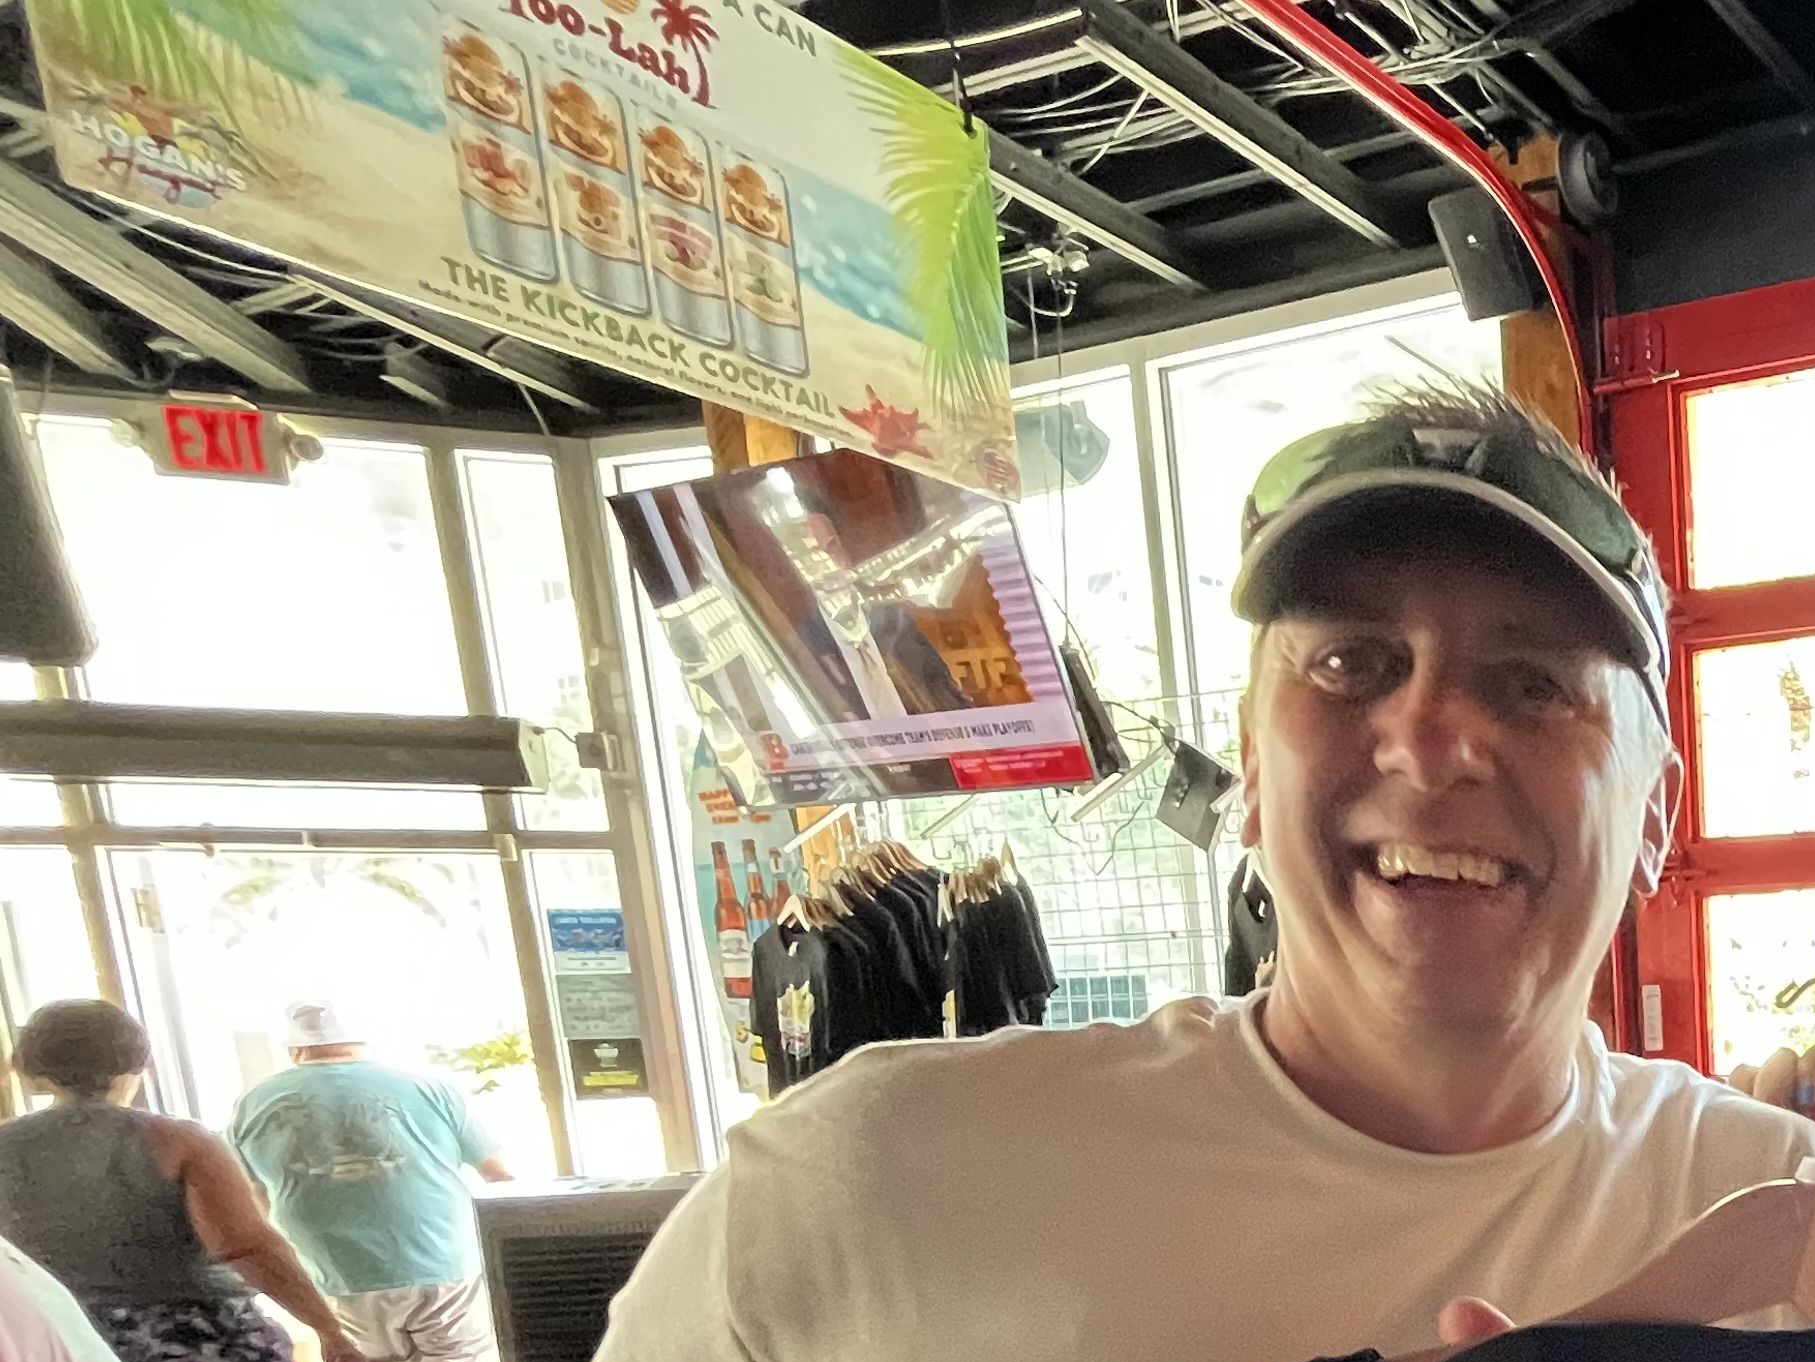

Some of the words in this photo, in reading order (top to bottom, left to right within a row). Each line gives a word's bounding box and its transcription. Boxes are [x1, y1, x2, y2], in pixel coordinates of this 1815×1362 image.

[754, 3, 817, 57] CAN
[70, 108, 248, 193] HOGAN'S
[440, 254, 510, 304] THE
[520, 283, 690, 369] KICKBACK
[697, 350, 837, 420] COCKTAIL
[164, 404, 267, 476] EXIT
